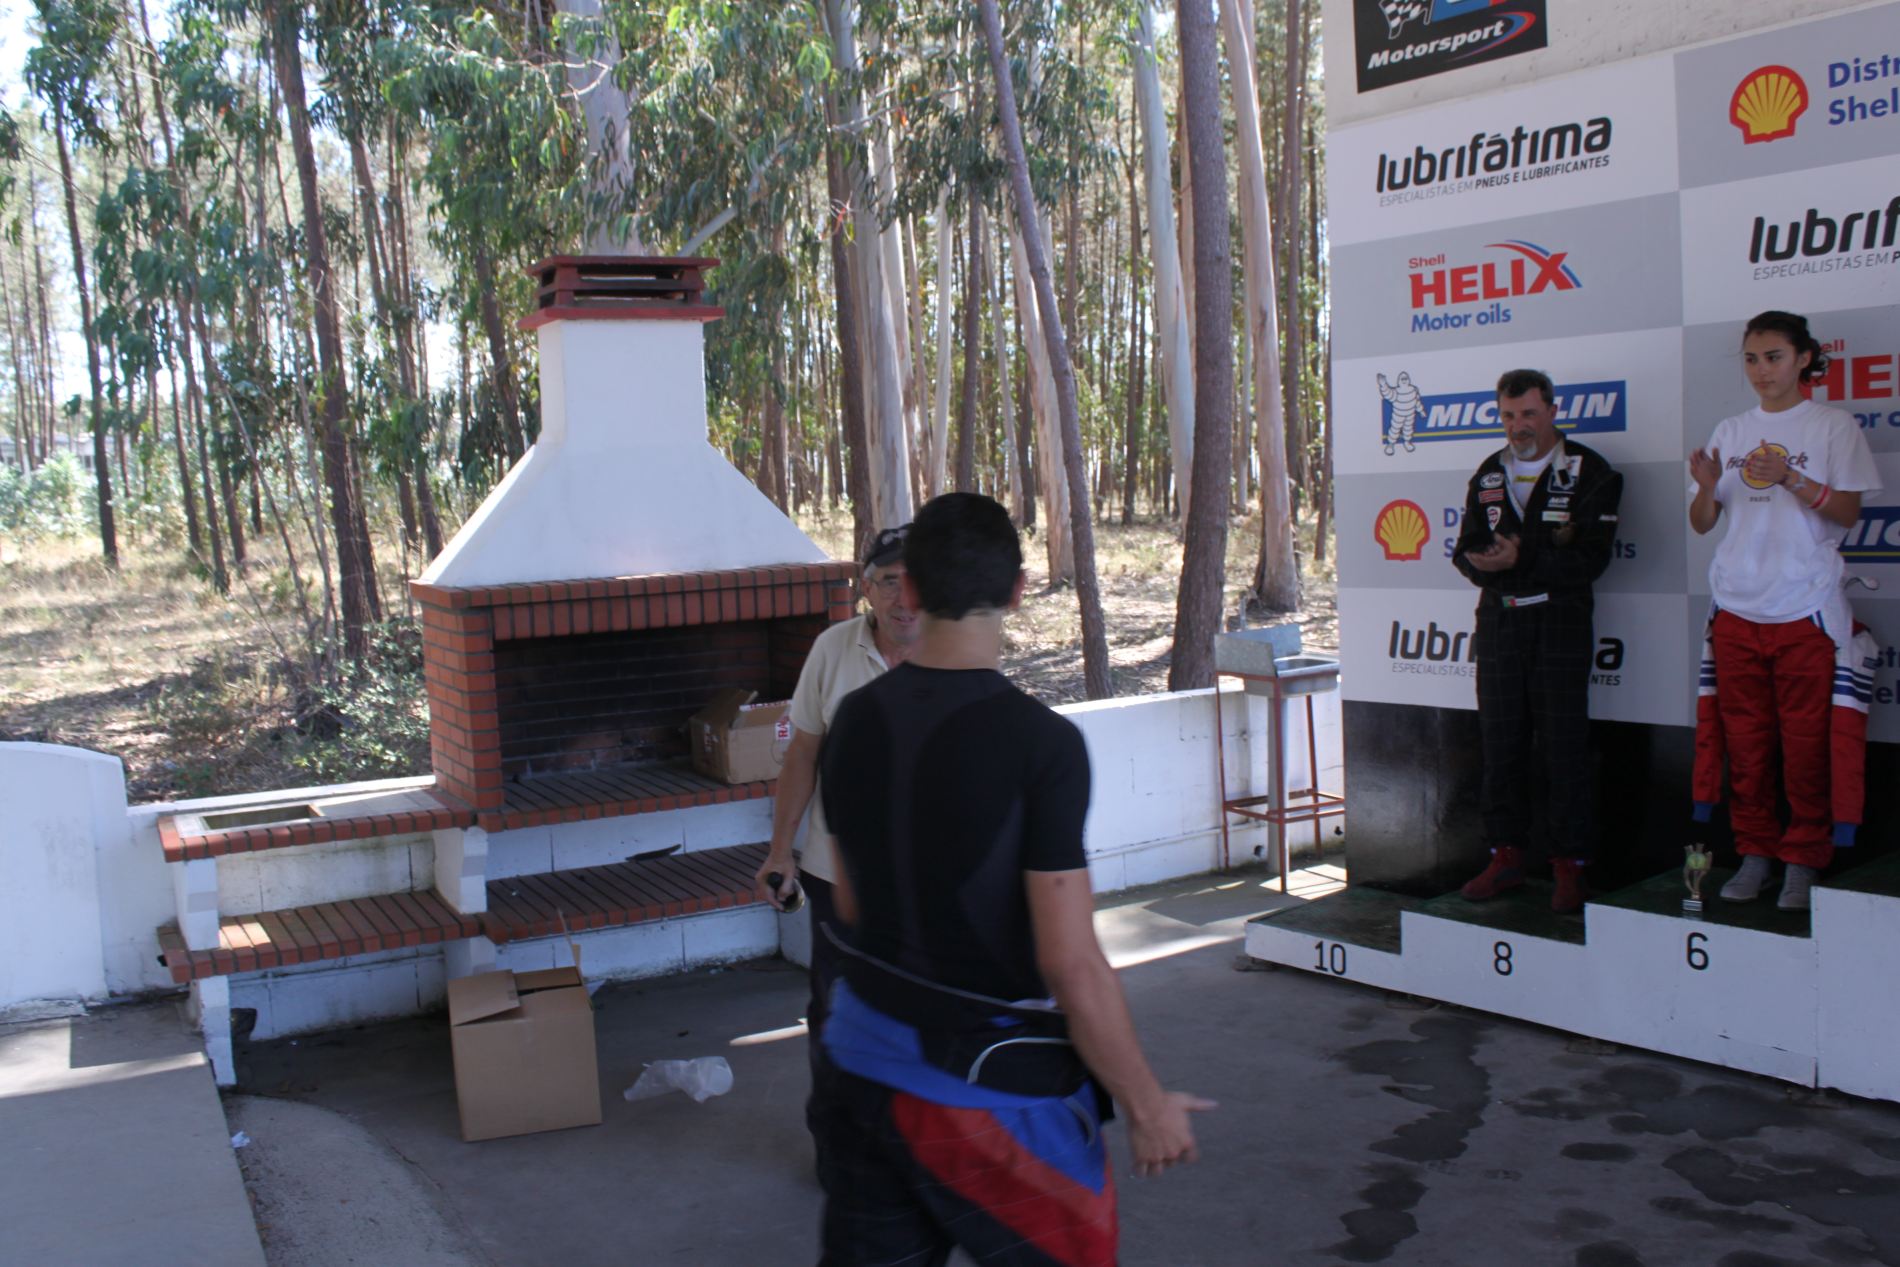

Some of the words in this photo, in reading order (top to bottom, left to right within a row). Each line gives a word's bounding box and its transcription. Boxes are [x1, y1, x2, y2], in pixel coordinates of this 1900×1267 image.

[1367, 20, 1505, 69] Motorsport
[1379, 182, 1455, 208] ESPECIALISTAS
[1457, 181, 1474, 194] EM
[1475, 173, 1511, 190] PNEUS
[1513, 171, 1521, 183] E
[1522, 154, 1611, 181] LUBRIFICANTES
[1408, 254, 1445, 269] Shell
[1753, 253, 1862, 281] ESPECIALISTAS
[1865, 252, 1889, 267] EM
[1408, 250, 1576, 309] HELIX
[1411, 312, 1472, 333] Motor
[1476, 303, 1512, 325] oils
[1820, 339, 1845, 354] ell
[1426, 392, 1618, 429] MICLIN
[1392, 661, 1467, 678] ESPECIALISTAS
[1314, 940, 1347, 976] 10
[1493, 941, 1513, 976] 8
[1686, 932, 1709, 971] 6
